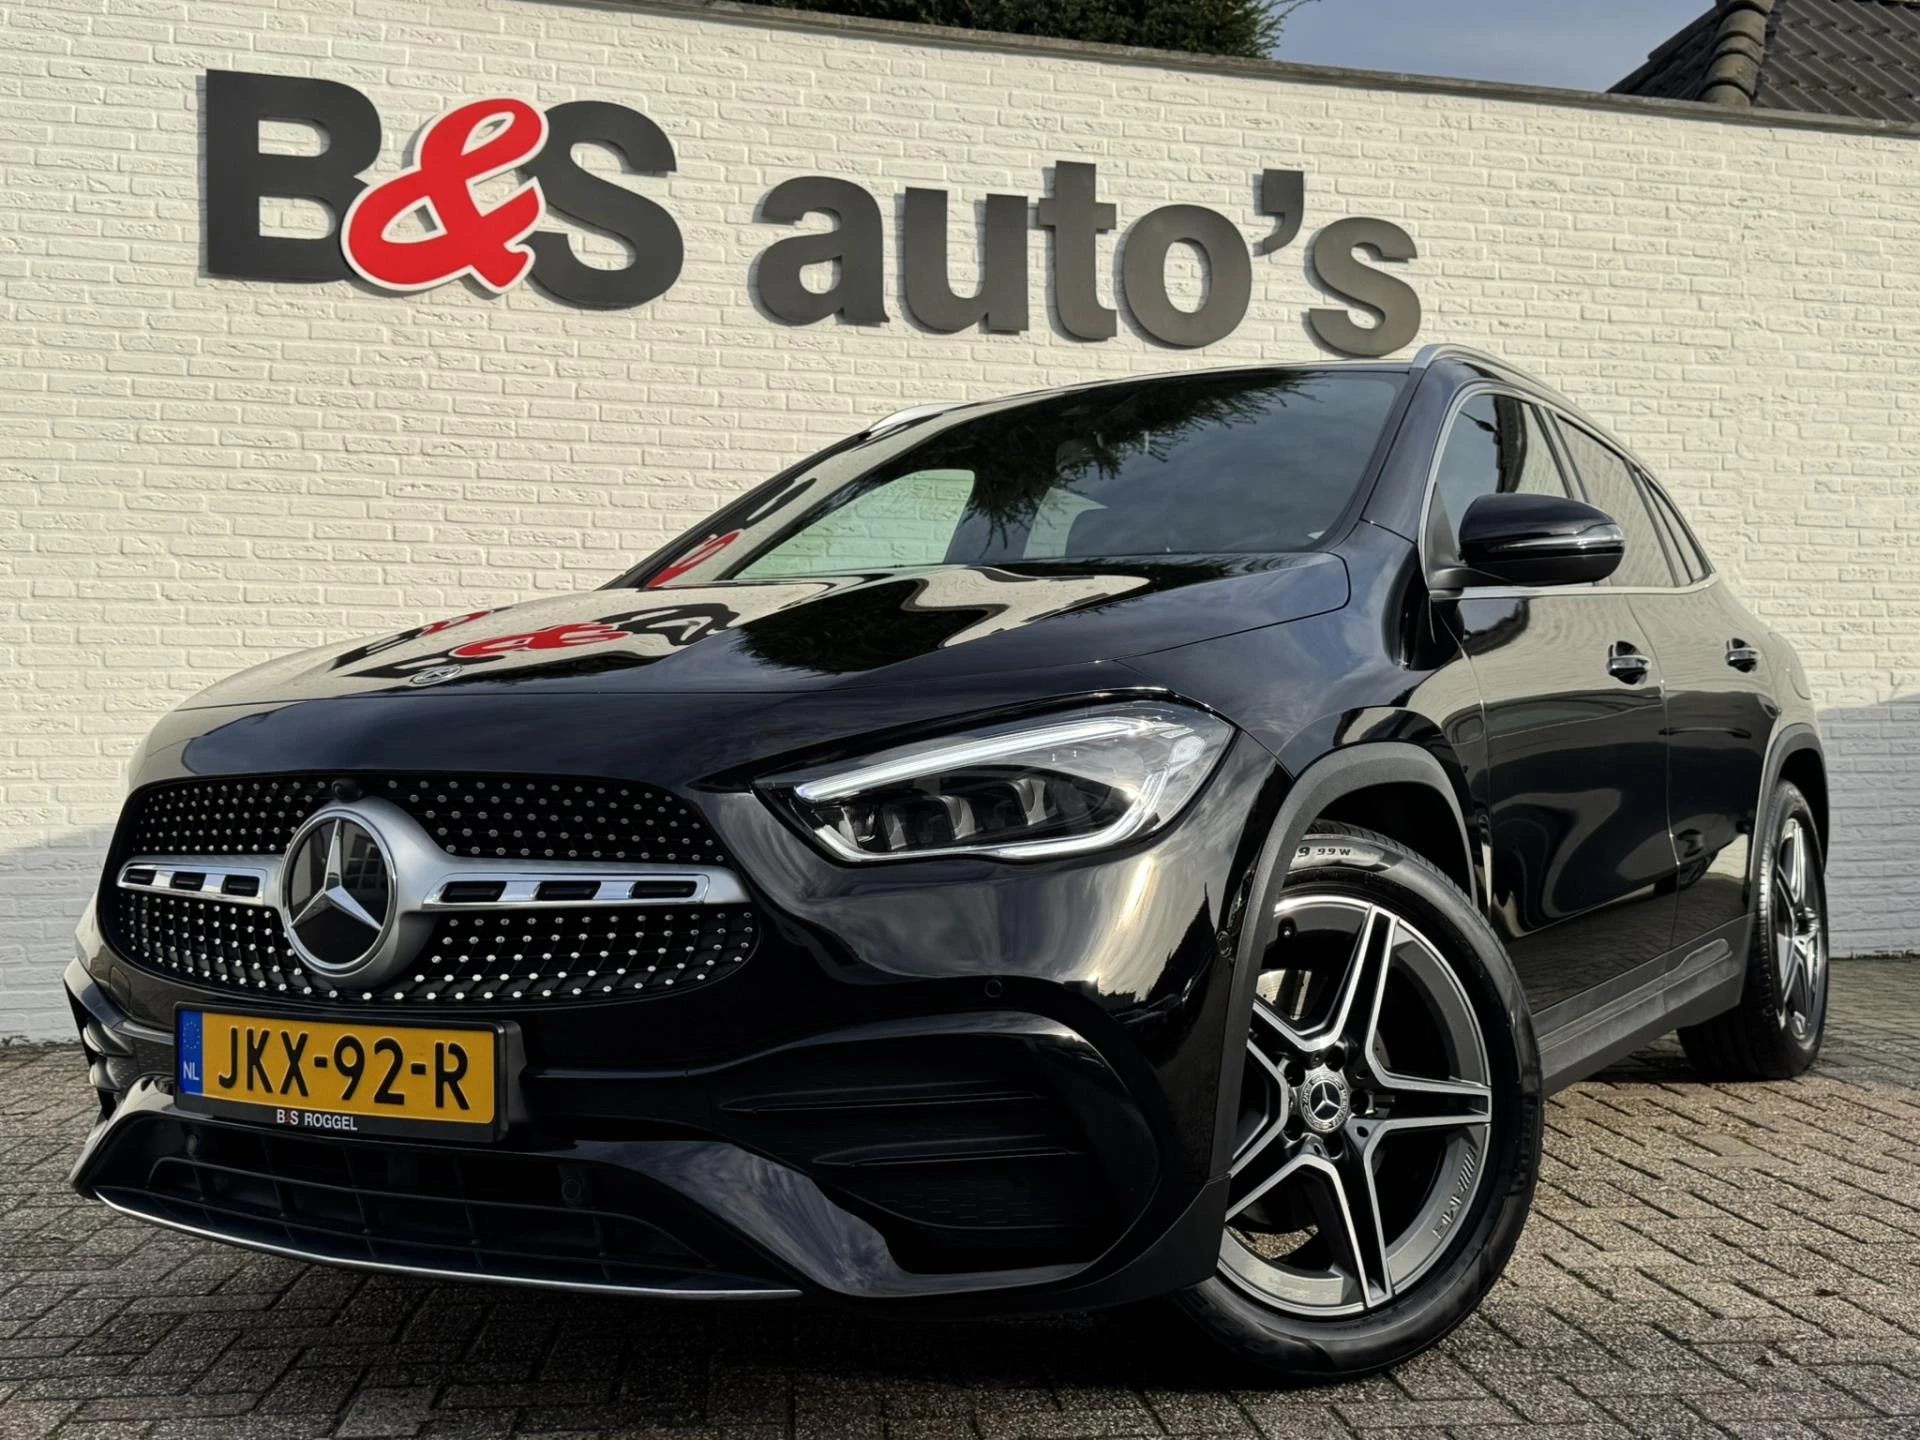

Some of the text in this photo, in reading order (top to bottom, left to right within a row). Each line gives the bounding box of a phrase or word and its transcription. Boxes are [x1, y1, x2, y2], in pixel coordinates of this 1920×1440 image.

[206, 69, 1422, 358] B&S auto's
[183, 1060, 200, 1081] NL
[218, 1026, 471, 1111] JKX-92-R
[304, 1112, 358, 1131] ROGGEL
